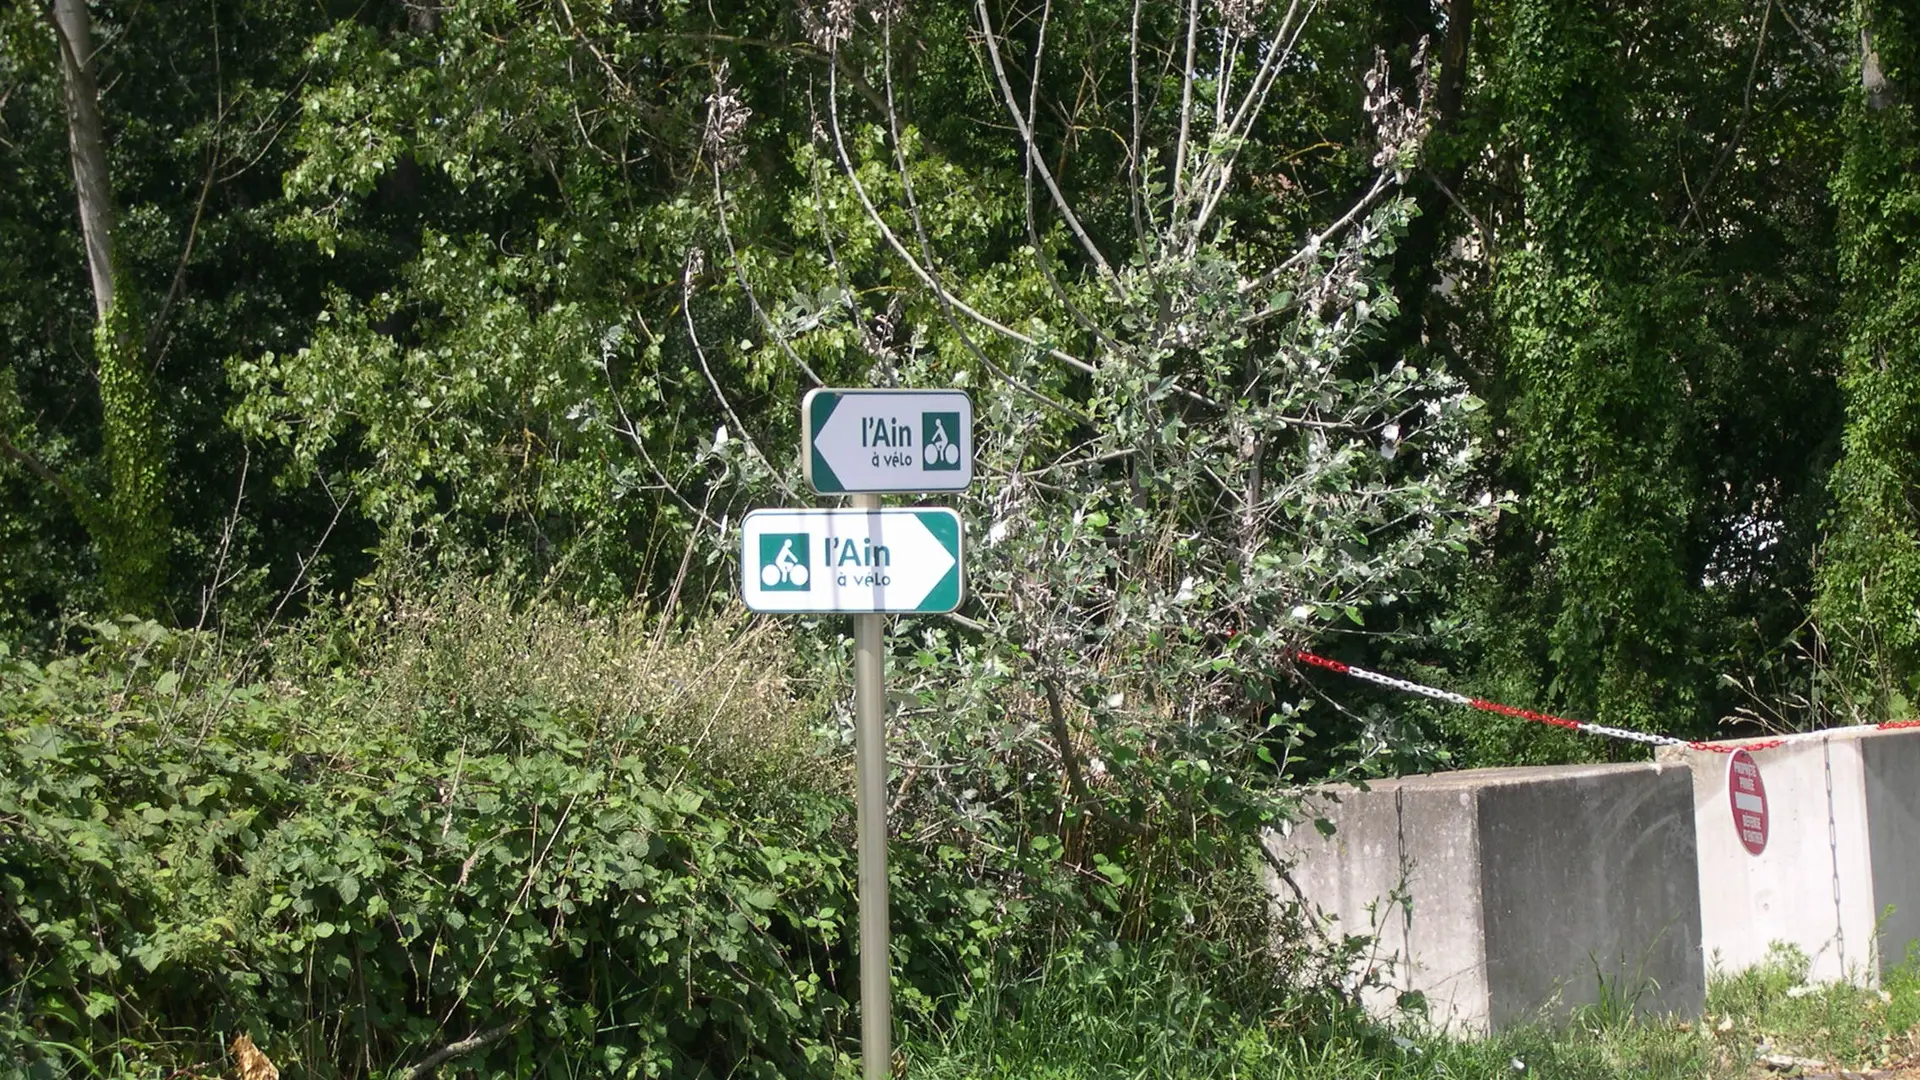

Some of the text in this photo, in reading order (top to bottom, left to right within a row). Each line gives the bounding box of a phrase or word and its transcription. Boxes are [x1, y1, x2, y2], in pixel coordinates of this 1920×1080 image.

[862, 416, 912, 447] l'Ain
[871, 451, 912, 468] à vélo
[825, 537, 890, 567] l'Ain
[837, 571, 891, 587] à vélo
